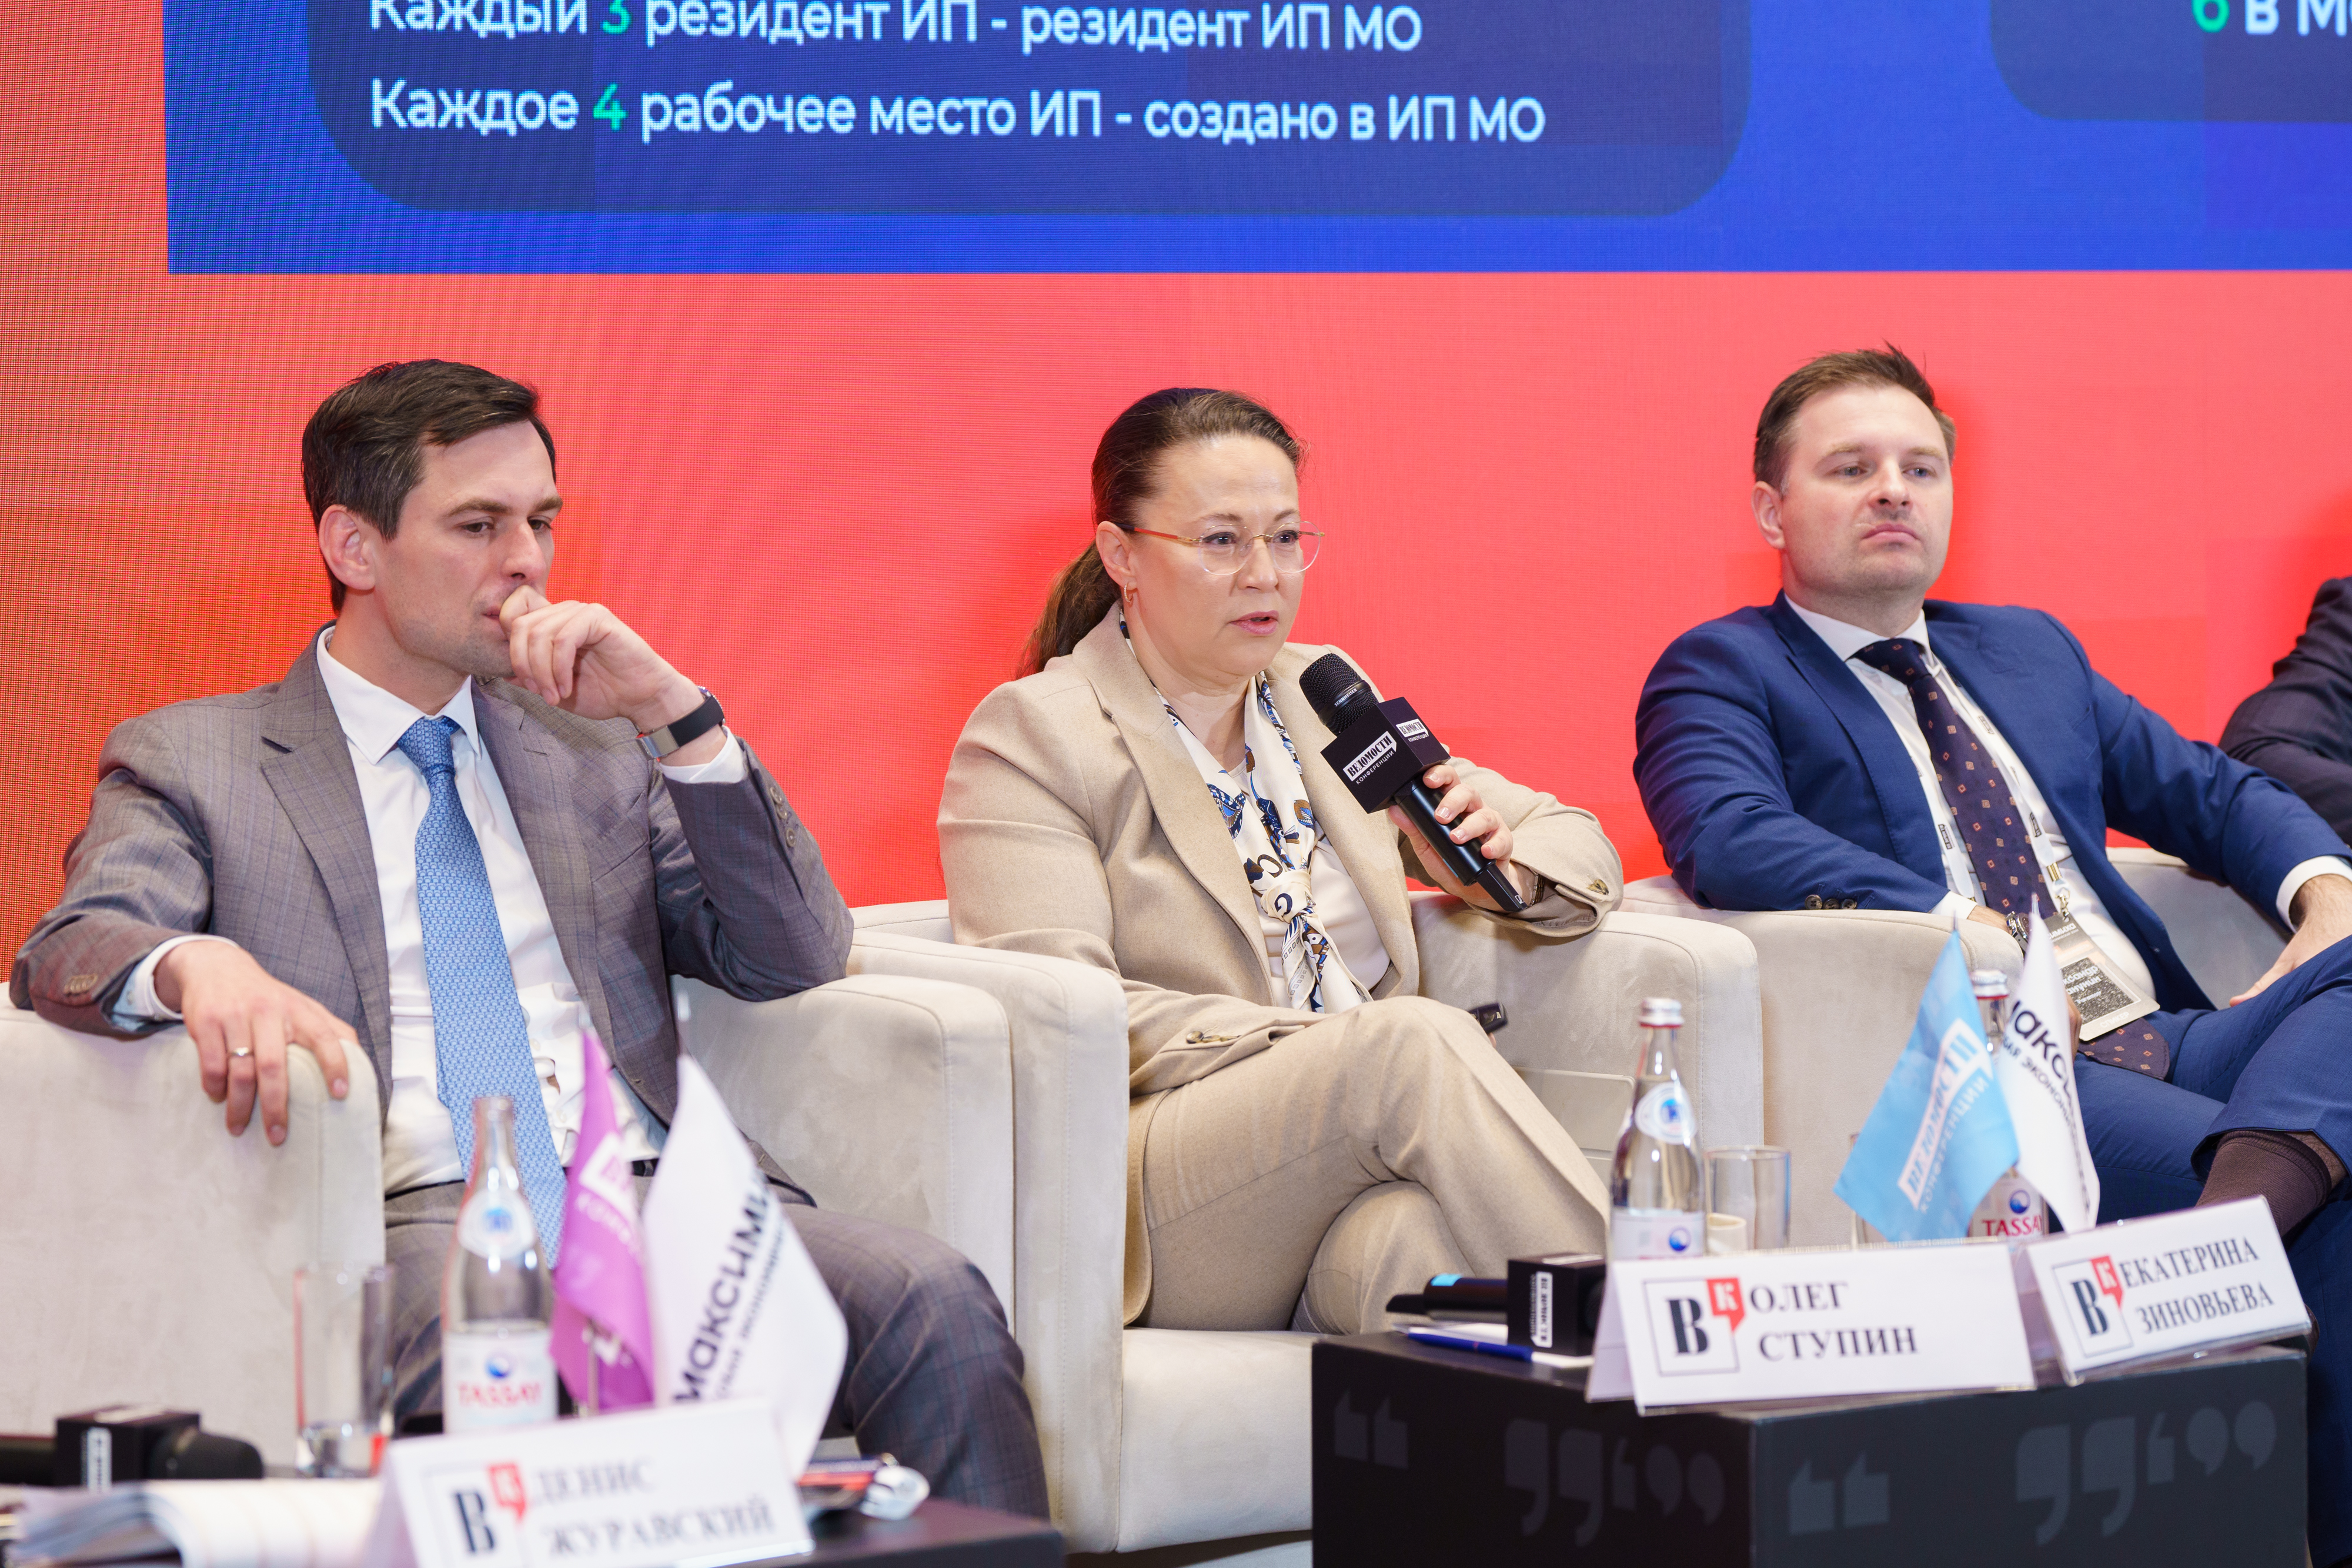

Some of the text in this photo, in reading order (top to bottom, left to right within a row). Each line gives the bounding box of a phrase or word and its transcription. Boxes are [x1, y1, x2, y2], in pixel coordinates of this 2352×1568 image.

[370, 0, 587, 39] Каждый
[602, 0, 630, 34] 3
[646, 0, 890, 47] резидент
[903, 0, 977, 41] ИП
[1022, 6, 1251, 54] резидент
[1262, 3, 1329, 49] ИП
[1345, 5, 1421, 51] МО
[2297, 0, 2352, 36] М
[372, 78, 579, 136] Каждое
[593, 83, 627, 130] 4
[642, 80, 856, 143] рабочее
[870, 96, 1016, 135] место
[1031, 90, 1100, 136] ИП
[1144, 101, 1337, 145] создано
[1350, 103, 1375, 140] в
[1389, 95, 1455, 141] ИП
[1469, 97, 1545, 142] МО
[1334, 688, 1358, 707] SENNHEISER
[1399, 721, 1424, 735] ВЕДОМОСТИ
[1347, 735, 1393, 778] ВЕДОМОСТИ
[1356, 751, 1394, 785] КОНФЕРЕНЦИИ
[2063, 965, 2099, 985] ксандр
[2066, 976, 2102, 995] анунин
[2100, 1011, 2130, 1028] СПИКЕР
[1982, 1214, 2042, 1236] TASSA
[2119, 1236, 2260, 1288] ЕКАТЕРИНА
[1750, 1282, 1848, 1313] ОЛЕГ
[2136, 1282, 2274, 1333] ЗИНОВЬЕВА
[1759, 1327, 1918, 1362] СТУПИН
[533, 1460, 657, 1506] ДЕНИС
[546, 1495, 774, 1557] ЖУРАВСКИЙ
